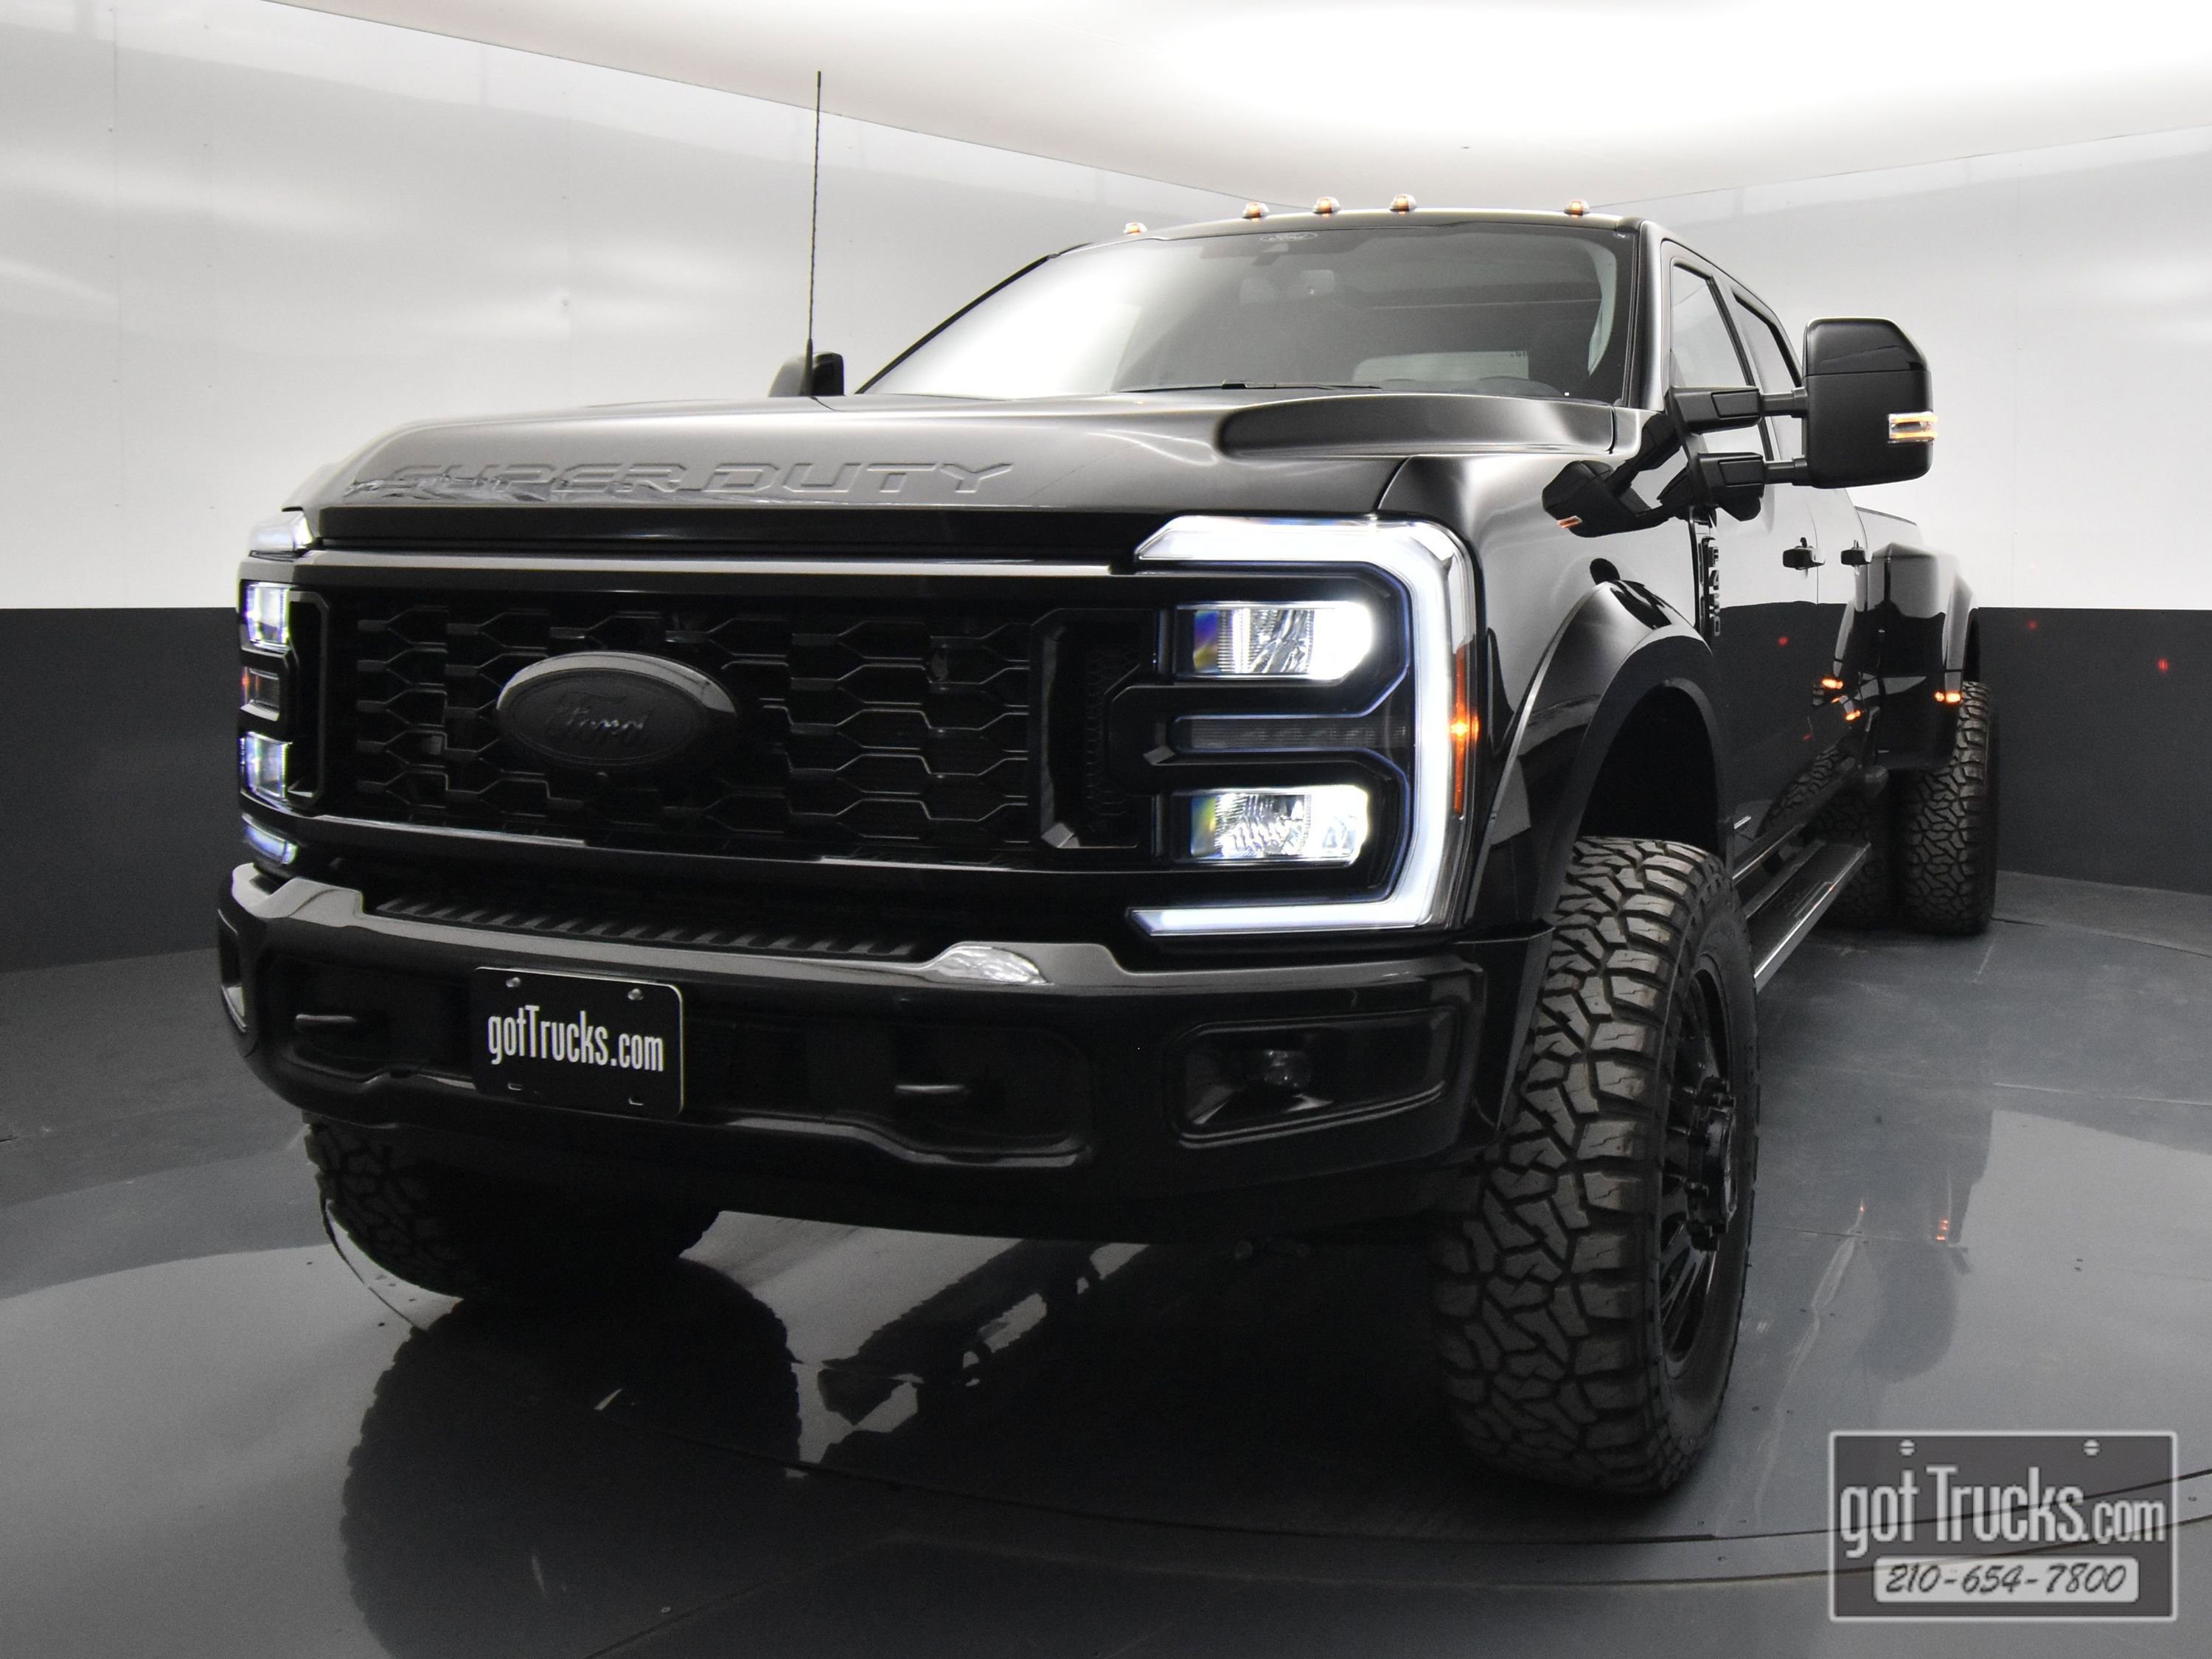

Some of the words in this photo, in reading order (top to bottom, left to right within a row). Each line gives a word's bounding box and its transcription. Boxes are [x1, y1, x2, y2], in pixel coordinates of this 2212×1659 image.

[378, 462, 687, 493] SUPER
[702, 462, 1014, 493] DUTY
[487, 1004, 664, 1071] gotTrucks.com
